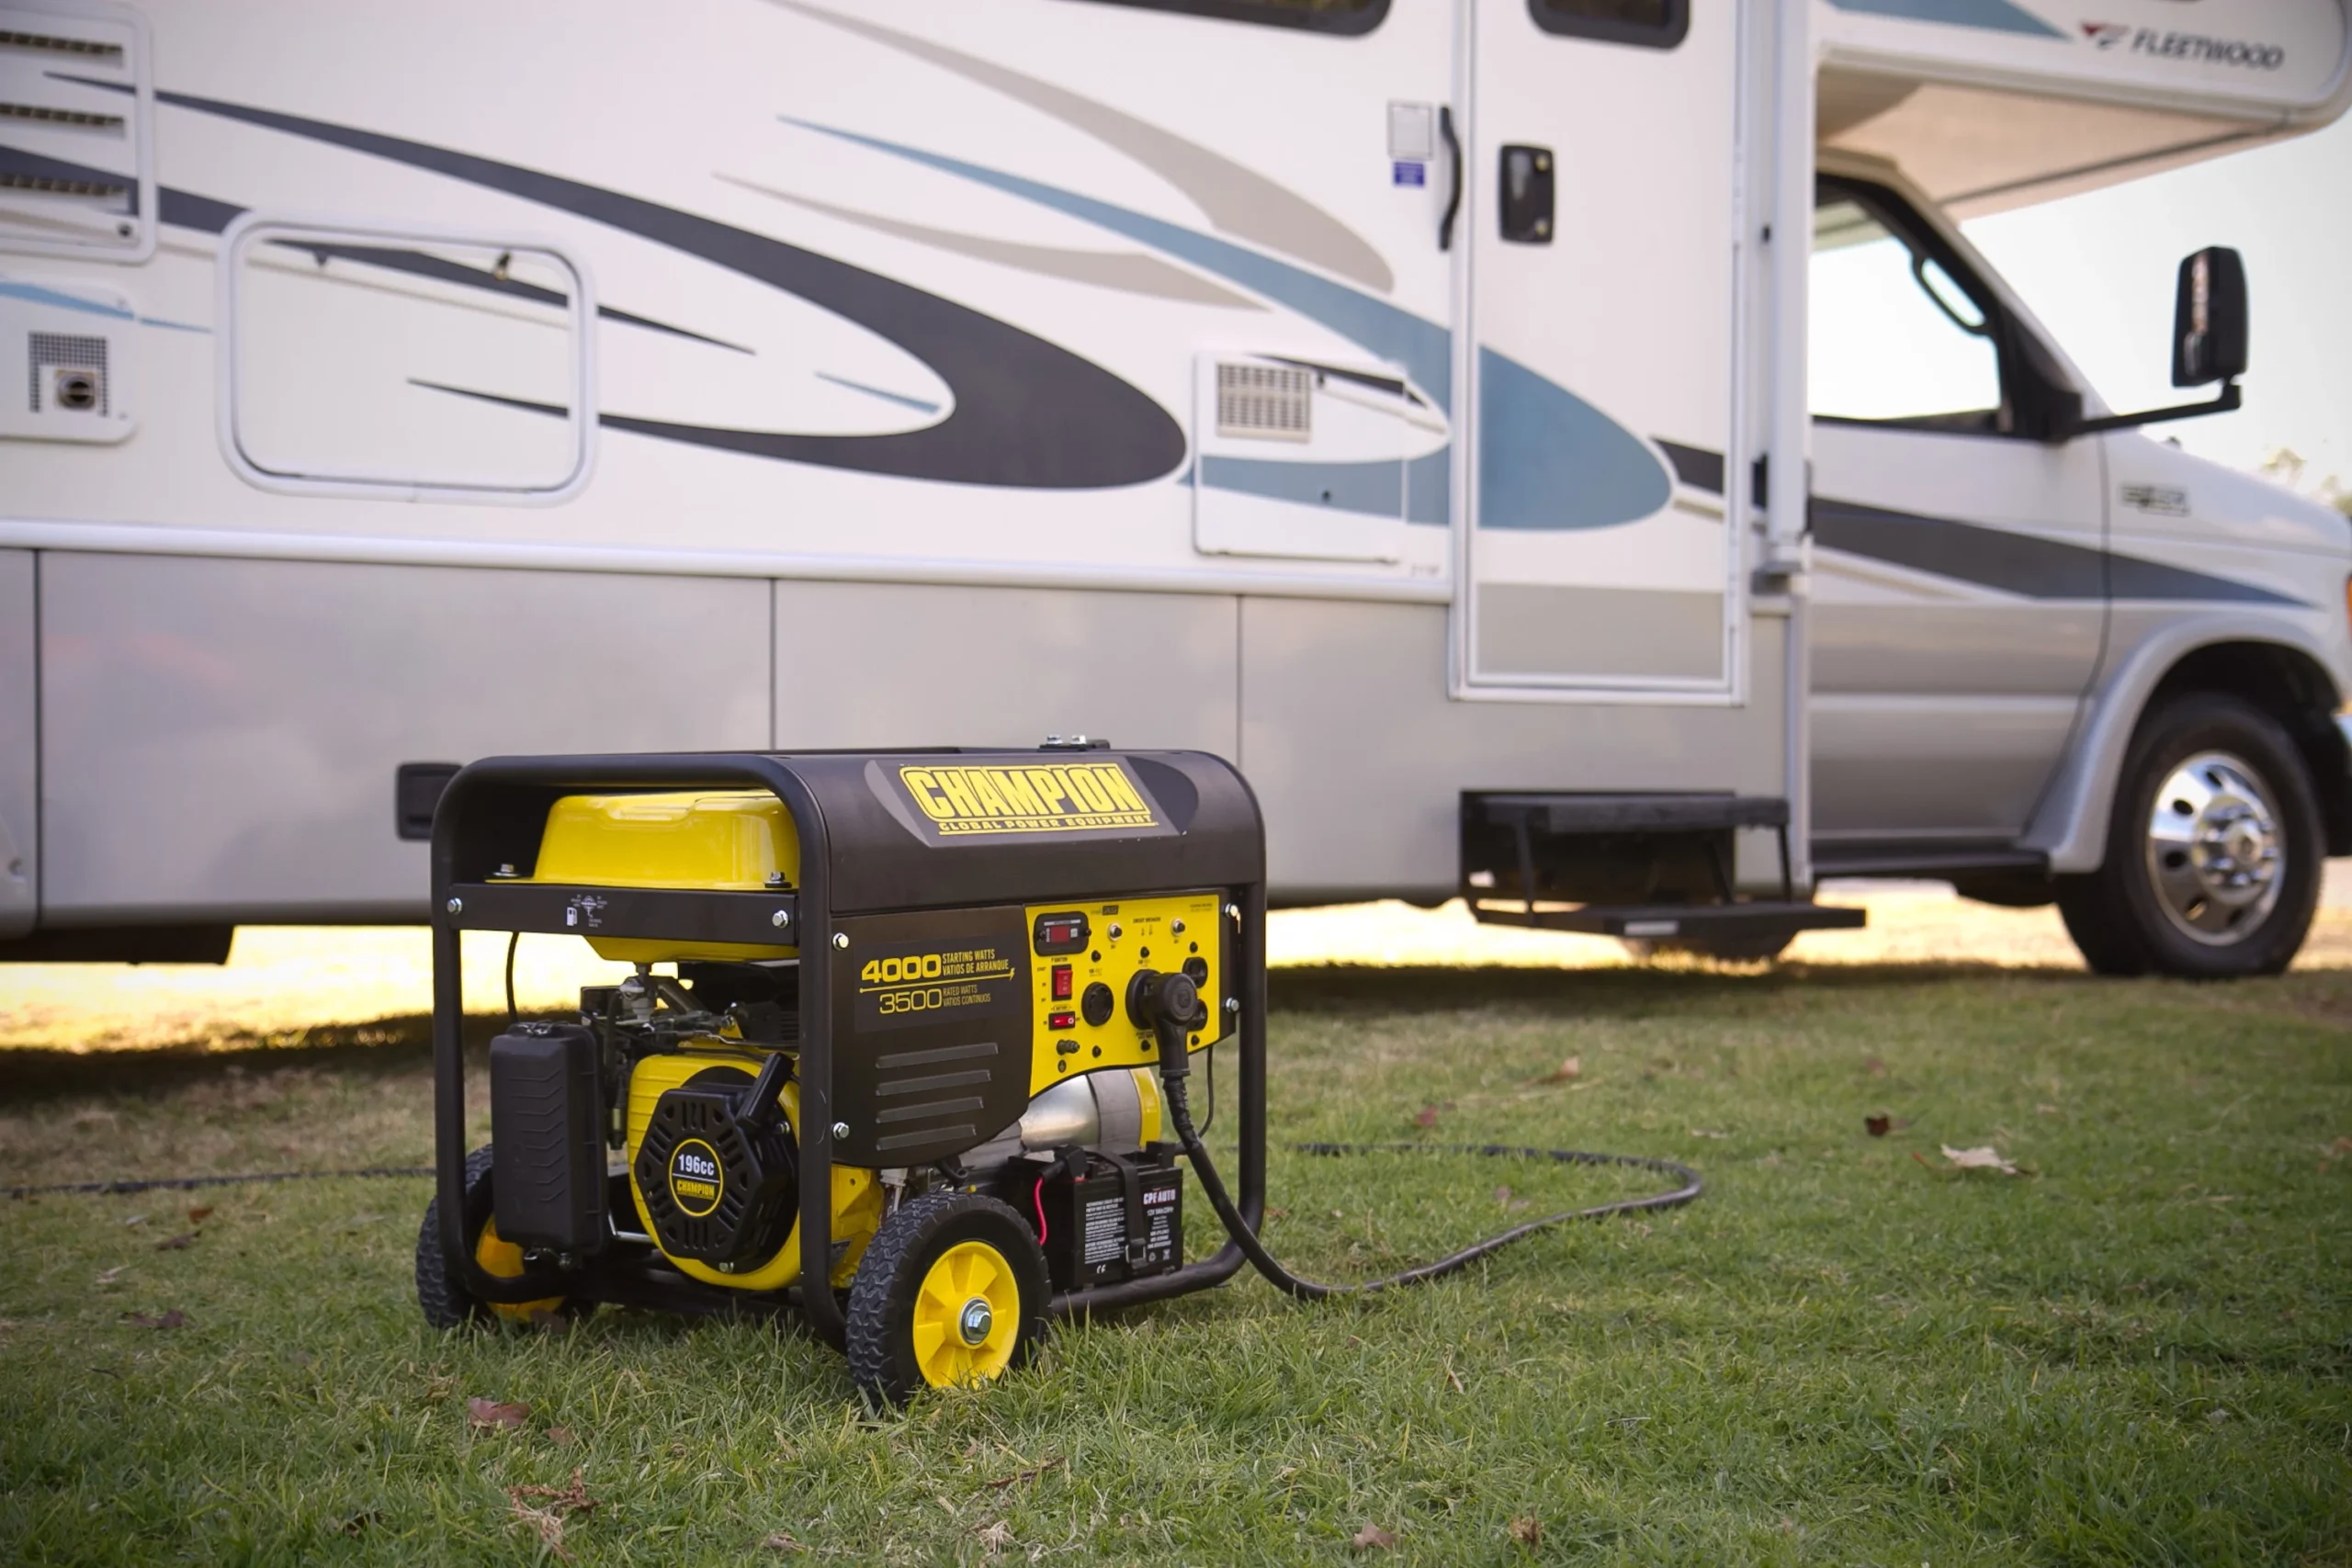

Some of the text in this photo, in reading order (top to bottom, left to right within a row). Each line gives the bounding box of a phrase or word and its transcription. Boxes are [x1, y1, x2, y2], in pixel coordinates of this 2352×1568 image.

[2132, 27, 2286, 71] FLEETWOOD
[904, 766, 1146, 819] CHAMPION
[938, 814, 1152, 831] GLOBAL POWER EQUIPMENT
[942, 948, 996, 964] STARTING WATTS
[861, 953, 942, 984] 4000
[942, 958, 1010, 976] VATIOS DE ARRANQUE
[943, 984, 978, 997] RATED WATTS
[879, 987, 943, 1014] 3500
[943, 996, 961, 1007] VATIOS
[678, 1154, 715, 1176] 196cc
[676, 1179, 715, 1198] CHAMPION
[1157, 1189, 1176, 1202] AUTO
